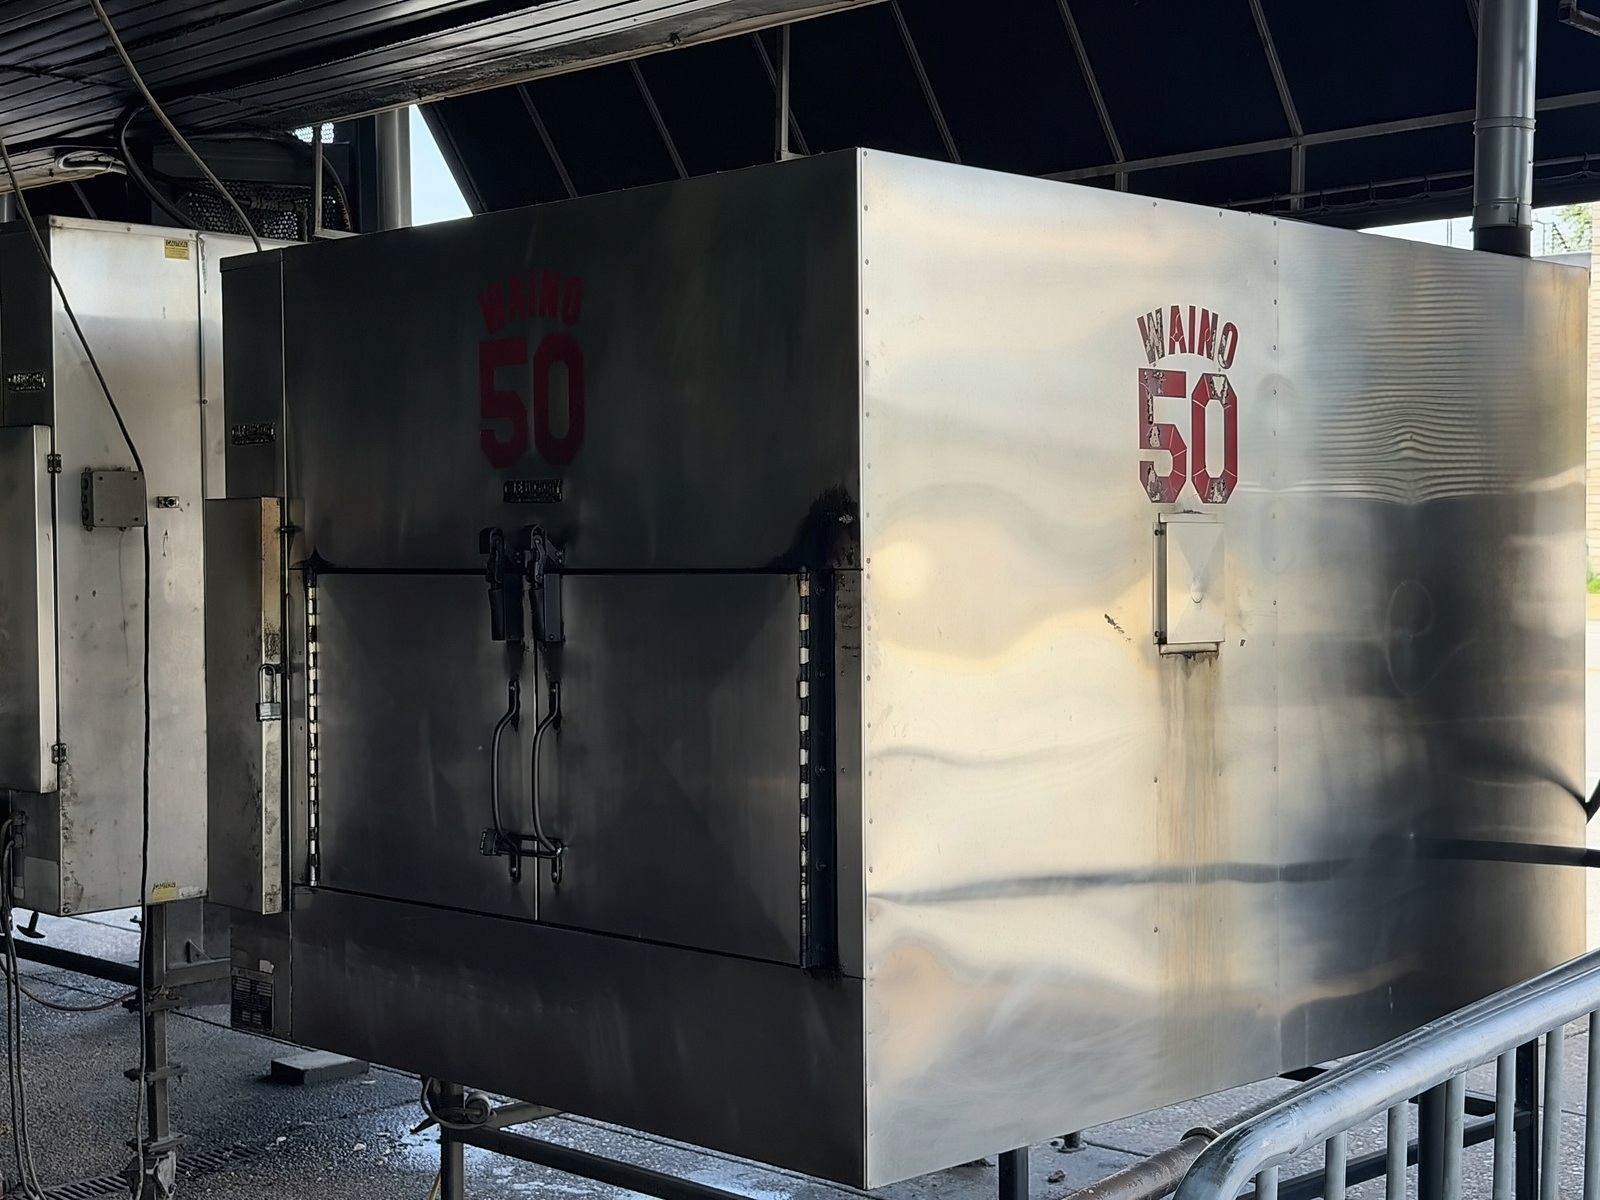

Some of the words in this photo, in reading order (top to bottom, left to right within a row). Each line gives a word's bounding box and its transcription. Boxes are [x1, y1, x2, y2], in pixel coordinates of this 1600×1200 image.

[478, 267, 584, 335] WAINO
[1137, 305, 1239, 369] WAINO
[479, 332, 586, 469] 50
[1138, 367, 1238, 504] 50
